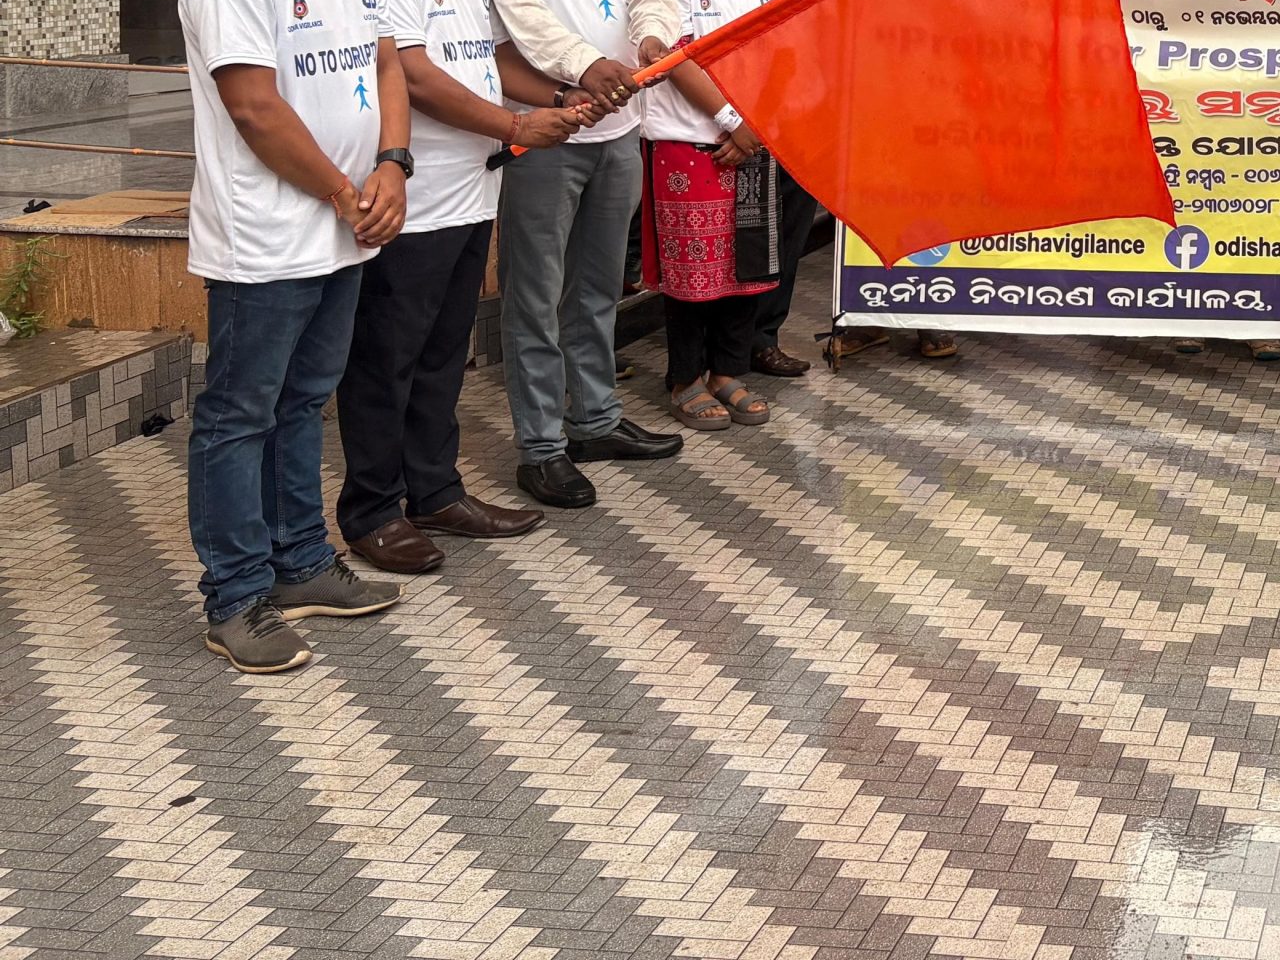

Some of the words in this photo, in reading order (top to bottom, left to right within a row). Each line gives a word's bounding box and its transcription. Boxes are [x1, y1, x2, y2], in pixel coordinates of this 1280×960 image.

[1131, 9, 1169, 31] ଠାରୁ
[294, 52, 317, 77] NO
[318, 49, 337, 74] TO
[959, 233, 1145, 258] @odishavigilance
[859, 276, 957, 307] ଦୁର୍ନୀତି
[968, 277, 1094, 307] ନିବାରଣ
